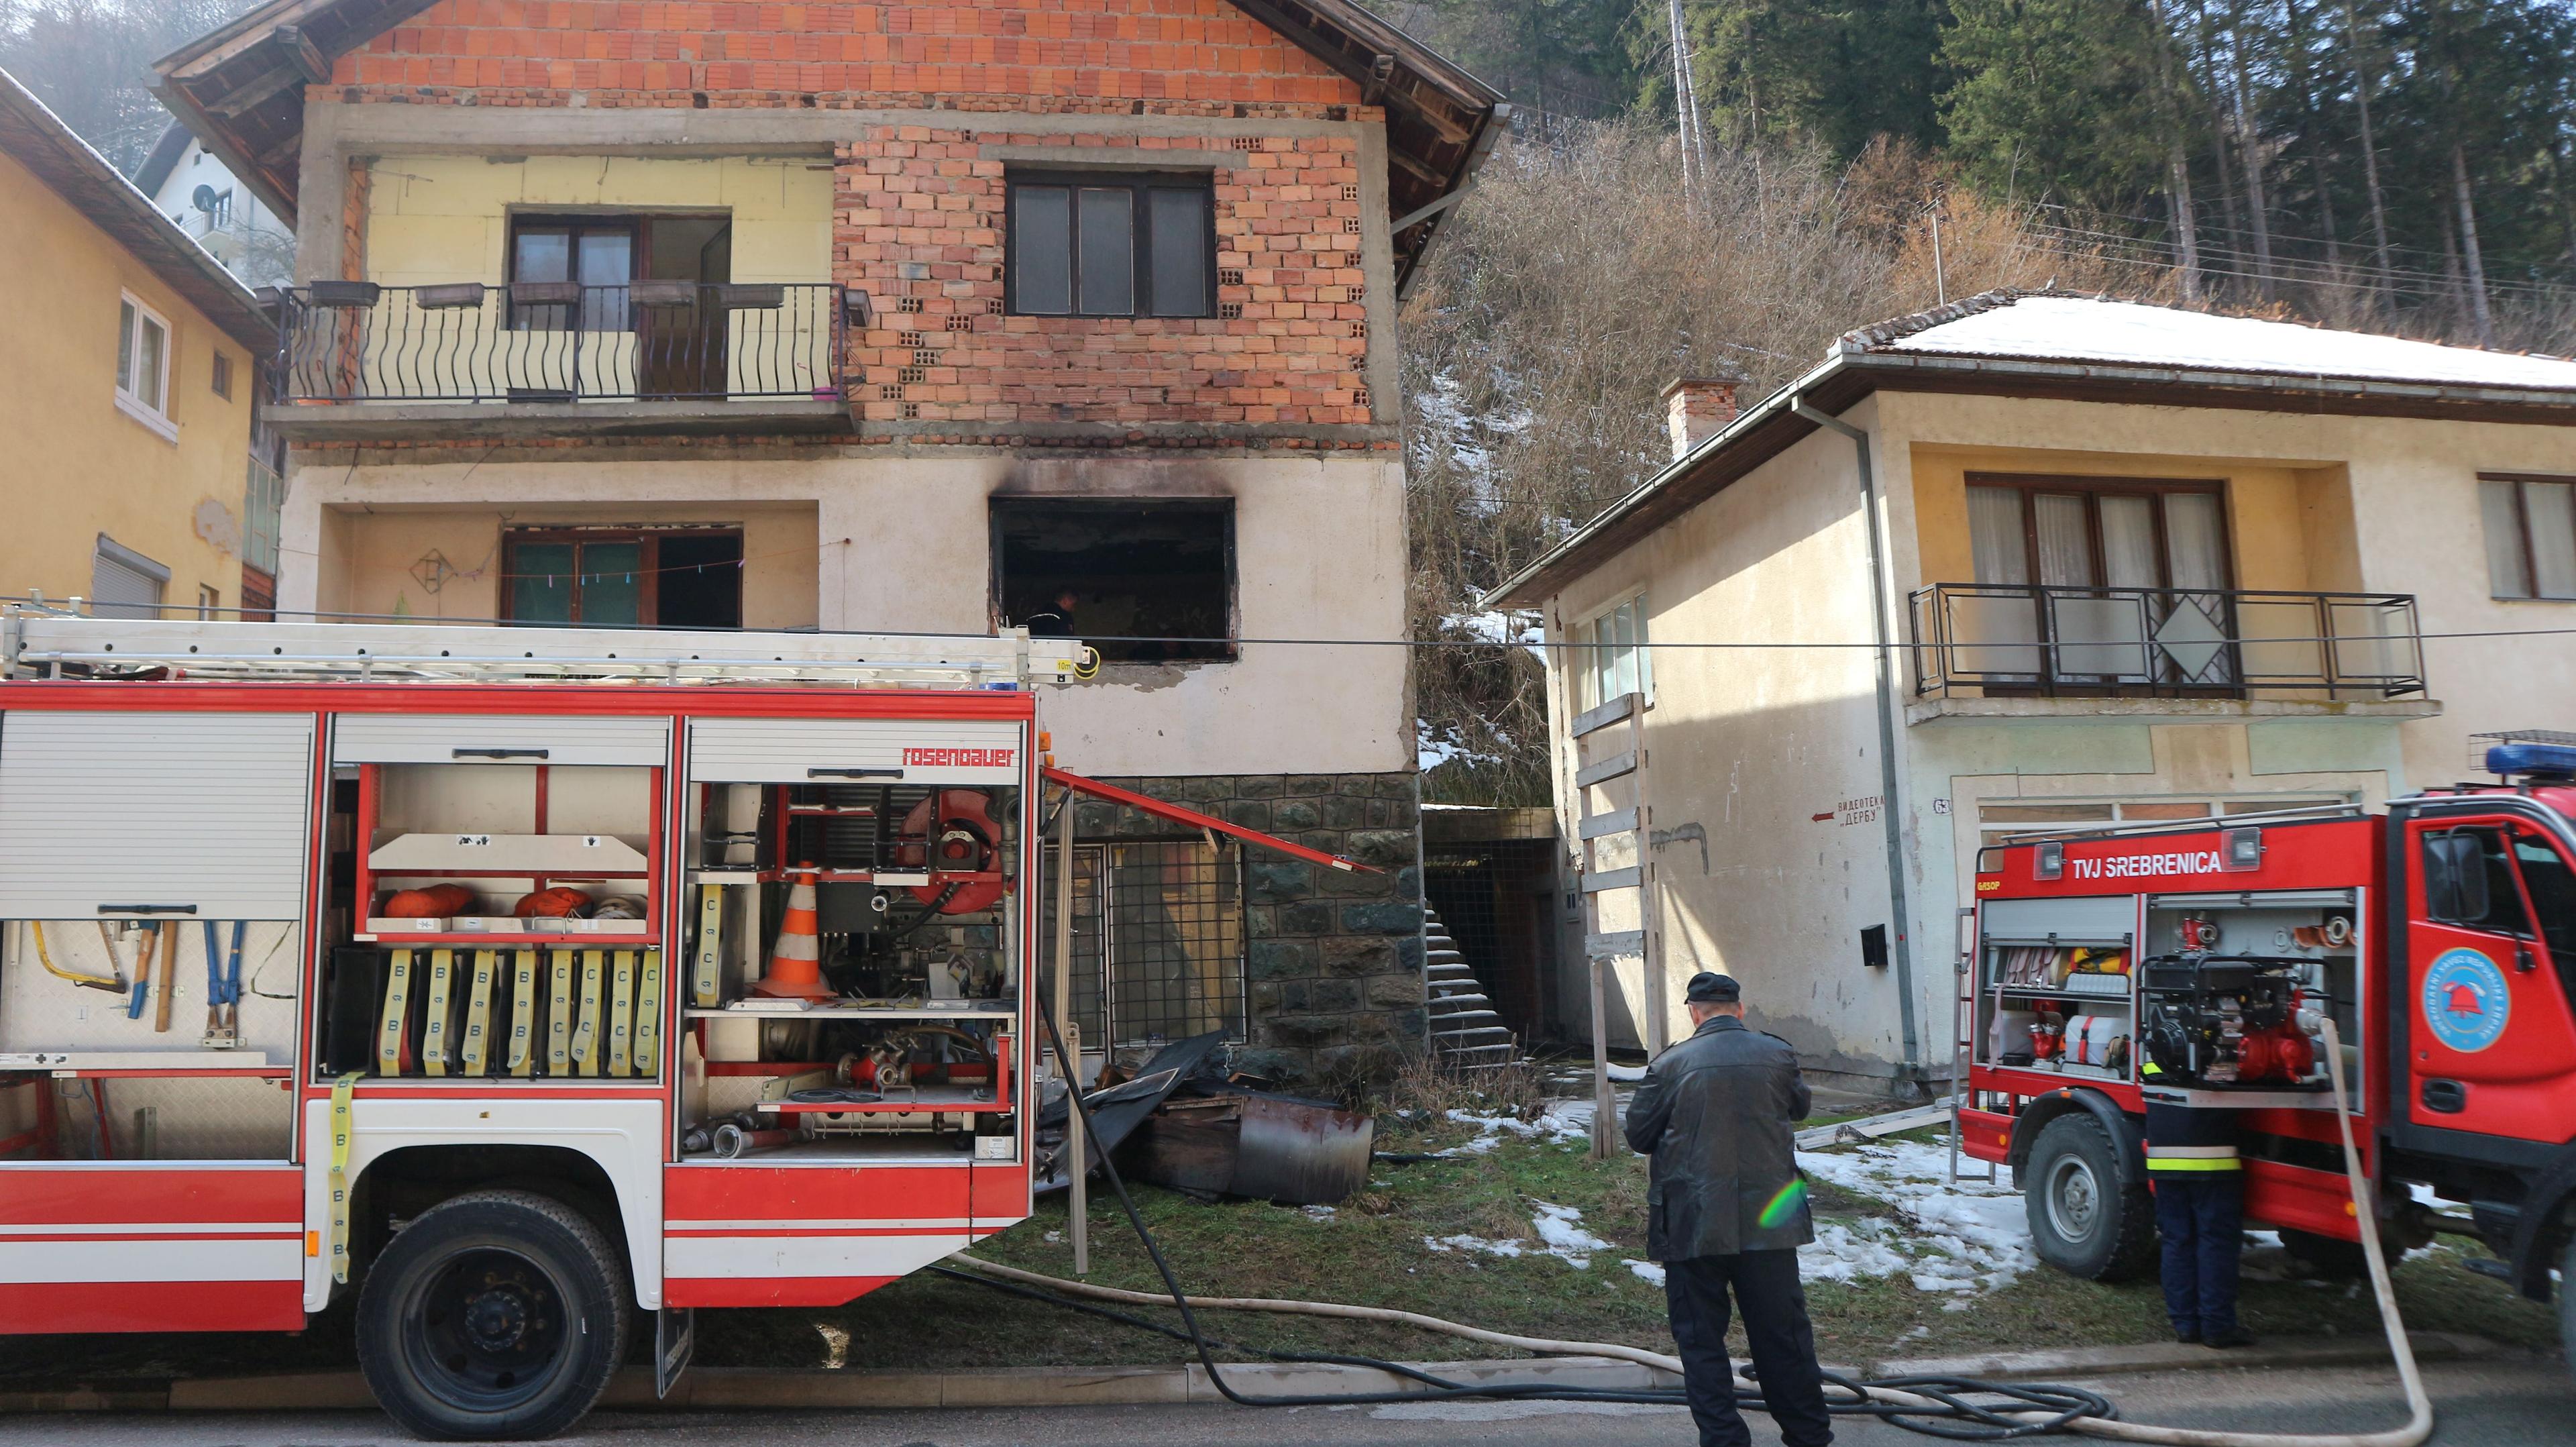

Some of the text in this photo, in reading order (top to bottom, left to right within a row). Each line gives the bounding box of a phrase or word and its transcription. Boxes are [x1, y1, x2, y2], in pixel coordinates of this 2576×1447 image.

[1058, 662, 1071, 670] 10m
[1839, 795, 1884, 812] ВИДЕОТЕКА
[1935, 800, 1949, 813] 63
[2073, 851, 2222, 879] TVJ SREBRENICA
